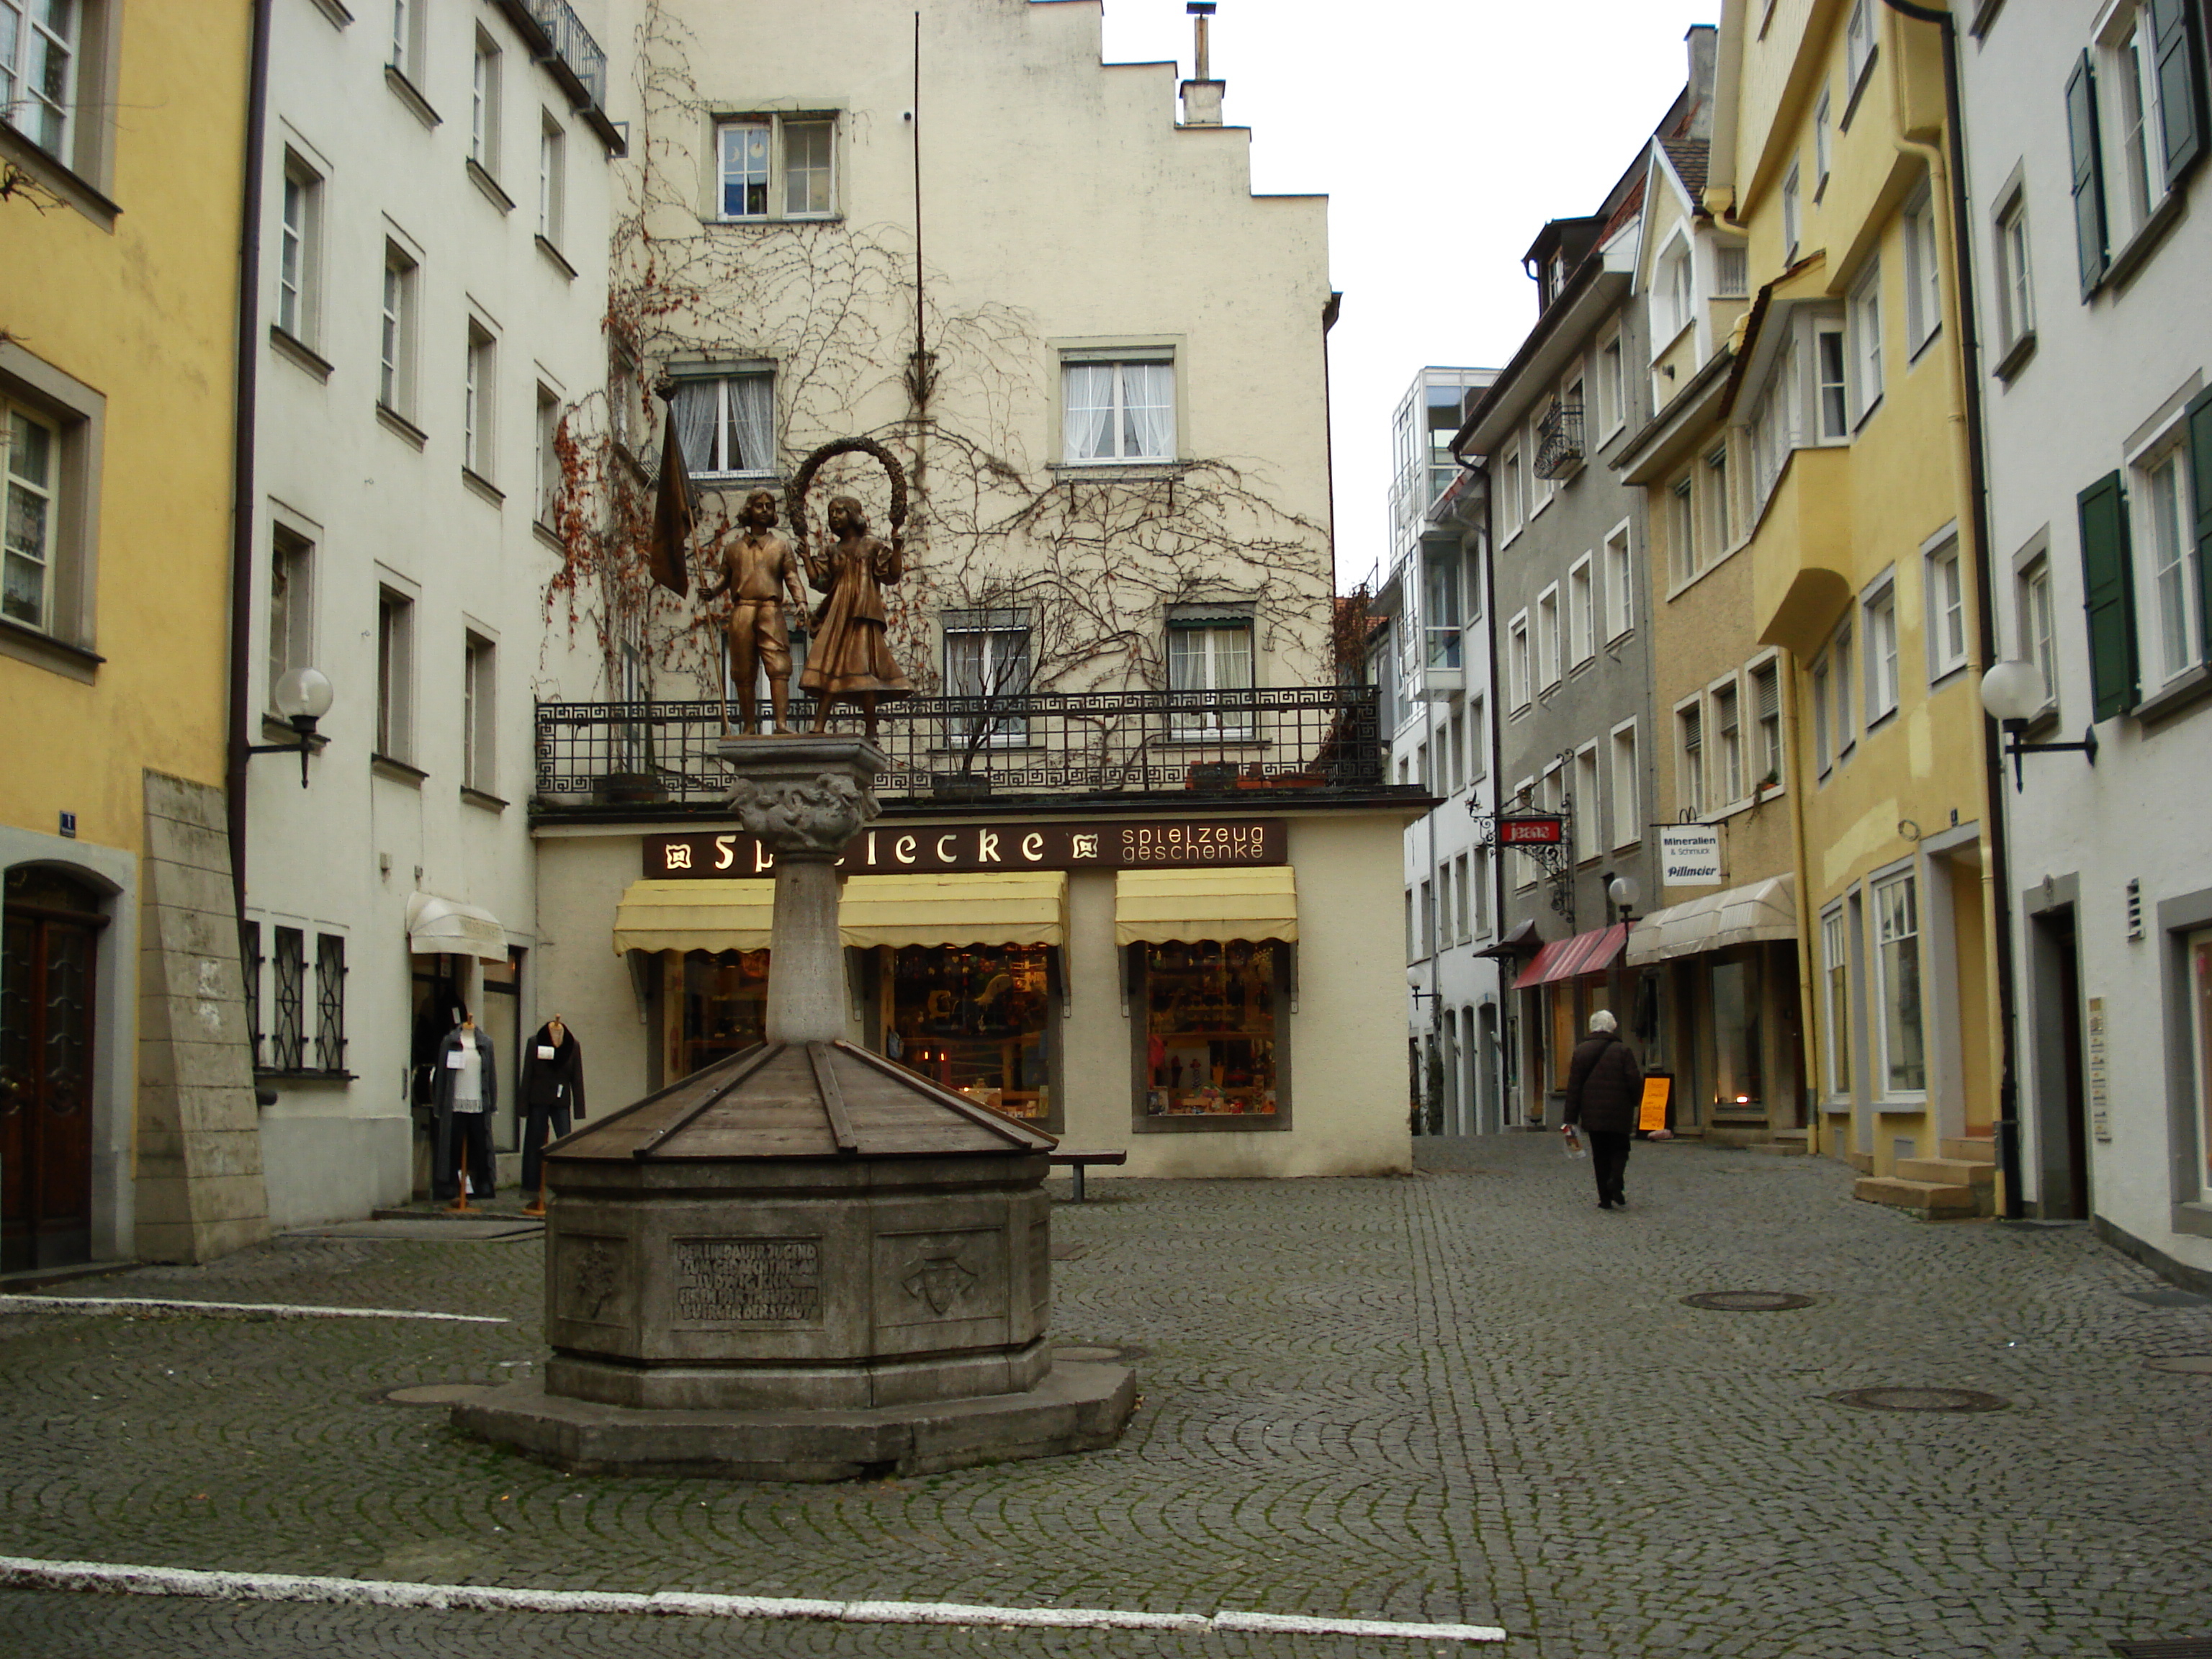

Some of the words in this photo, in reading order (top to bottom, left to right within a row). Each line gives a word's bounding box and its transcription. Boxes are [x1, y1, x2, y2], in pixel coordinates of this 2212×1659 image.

[1122, 825, 1263, 847] spielzeug
[1509, 822, 1550, 842] jeans
[714, 828, 1043, 872] Splecke
[1122, 841, 1263, 863] geschenke
[1668, 866, 1717, 877] Pillmeier
